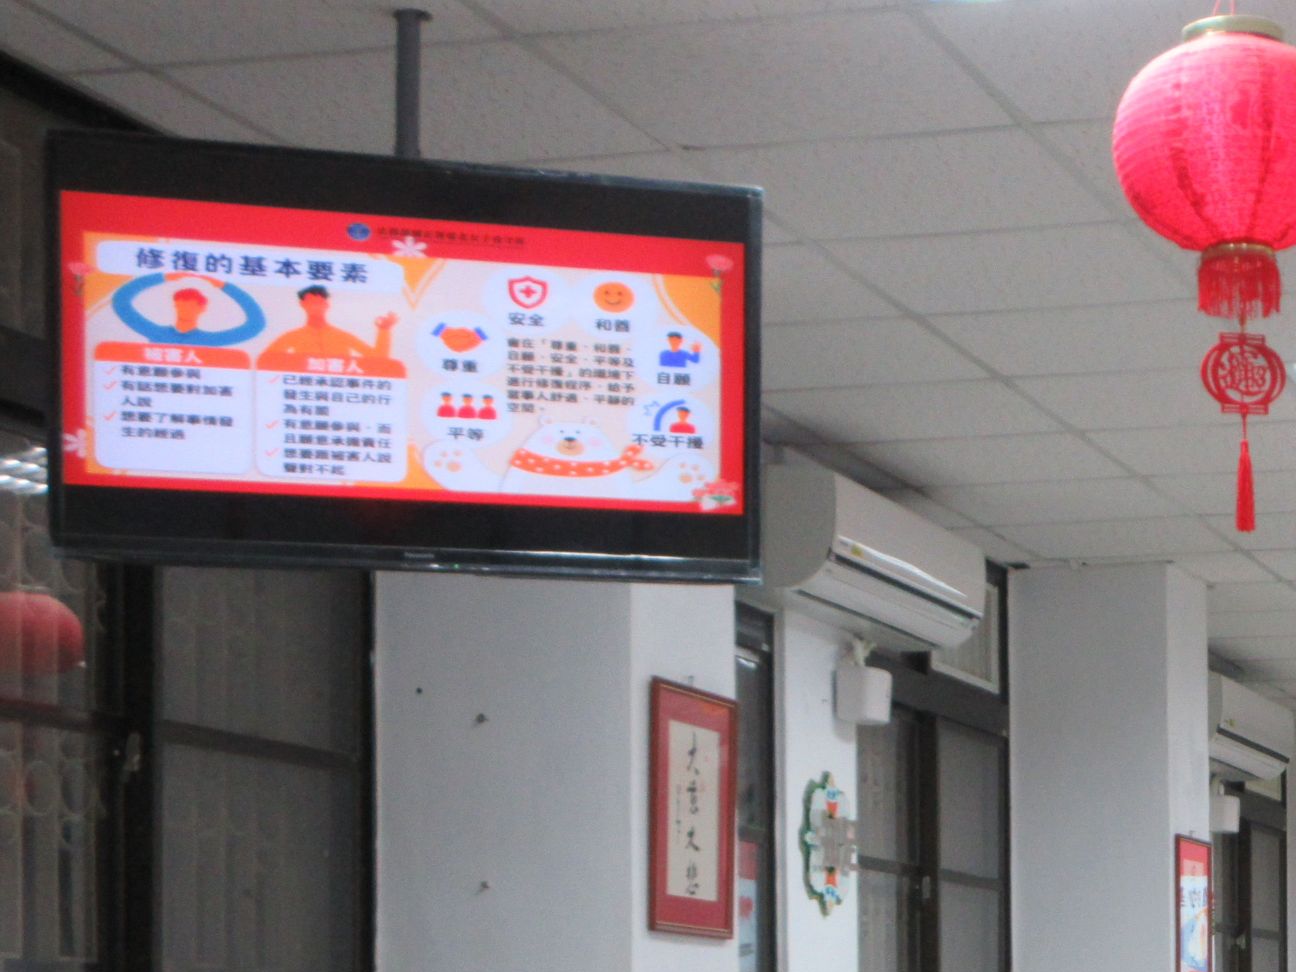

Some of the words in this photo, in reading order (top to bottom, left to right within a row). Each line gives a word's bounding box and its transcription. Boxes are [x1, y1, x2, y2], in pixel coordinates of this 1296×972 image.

[136, 248, 369, 284] 修復的基本要素
[508, 312, 544, 327] 安全
[594, 318, 631, 333] 和善
[307, 356, 365, 374] 加害人
[441, 358, 478, 373] 尊重
[657, 371, 691, 387] 自願
[448, 427, 485, 441] 平等
[633, 434, 705, 450] 不受干擾
